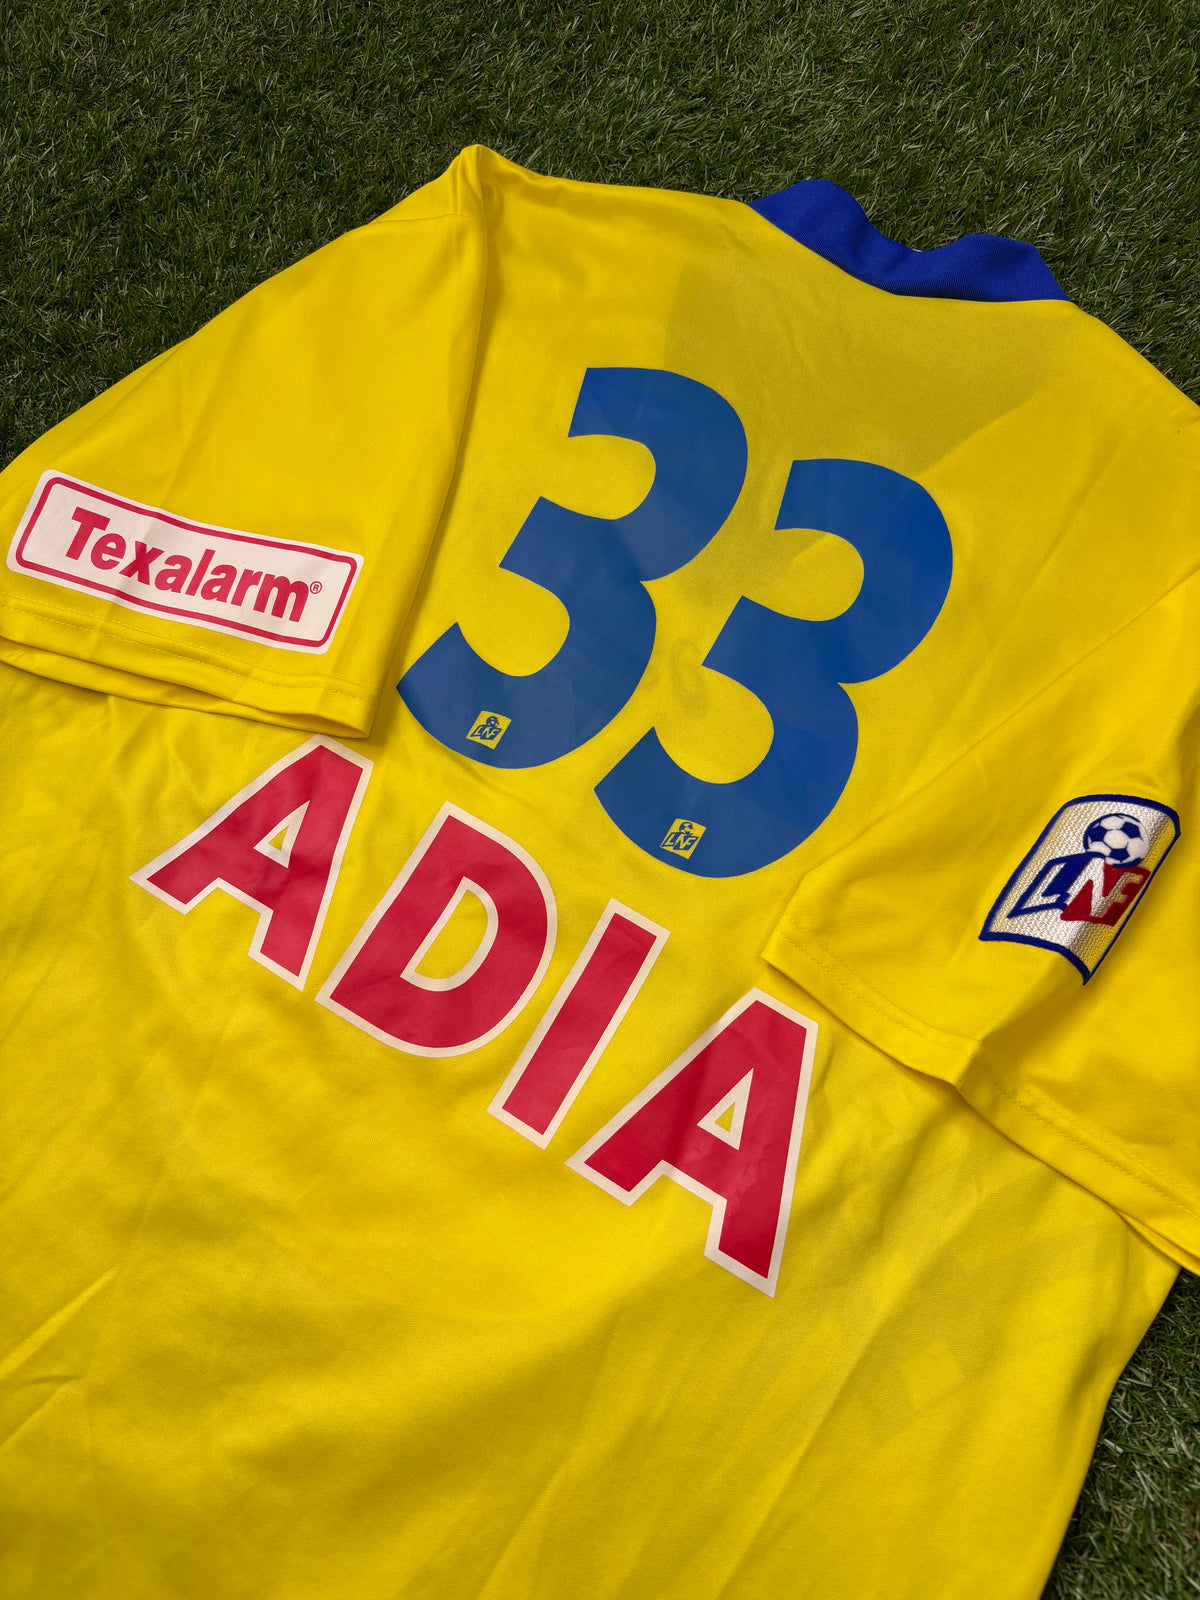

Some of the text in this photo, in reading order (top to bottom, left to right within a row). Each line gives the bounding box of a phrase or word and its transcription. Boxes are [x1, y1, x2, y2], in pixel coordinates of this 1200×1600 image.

[396, 367, 953, 878] 33
[661, 832, 699, 851] LNF
[1009, 854, 1150, 925] LNF
[130, 734, 819, 1298] ADIA
